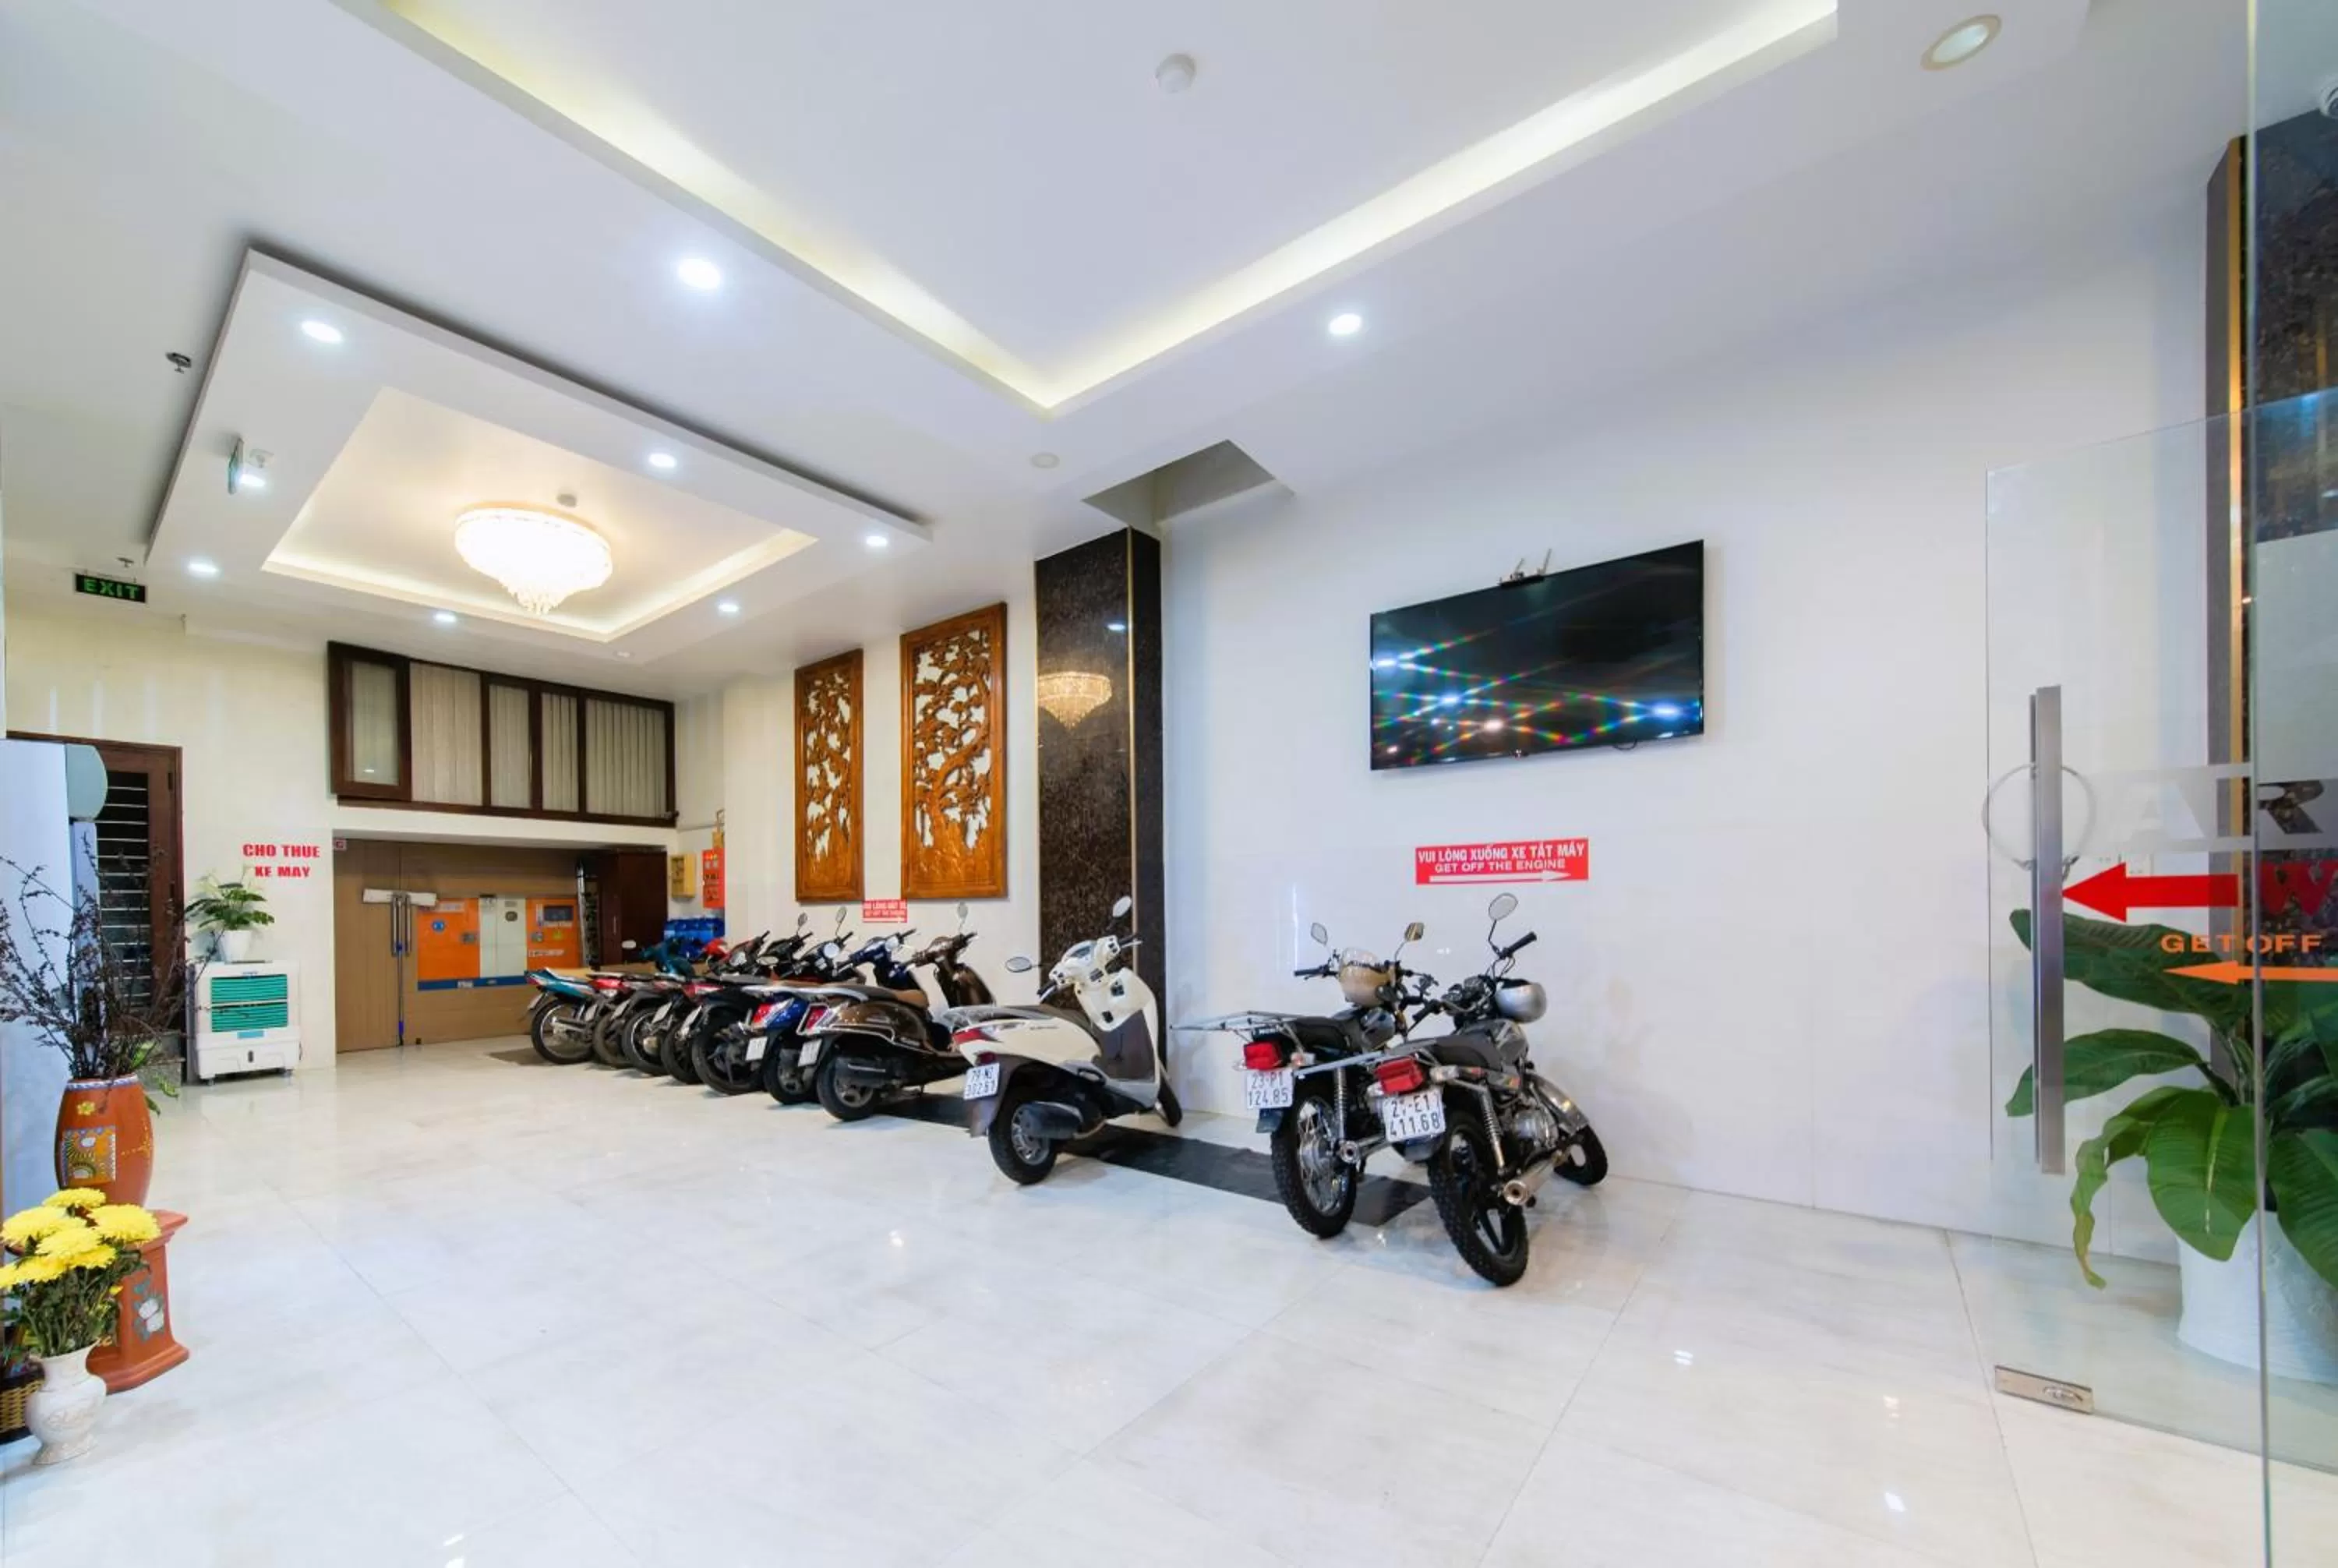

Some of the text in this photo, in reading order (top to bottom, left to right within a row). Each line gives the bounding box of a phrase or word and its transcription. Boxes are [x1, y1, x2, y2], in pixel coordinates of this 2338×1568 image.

[83, 577, 138, 599] EXIT
[242, 844, 277, 857] CHO
[1418, 850, 1436, 863] VUI
[1511, 846, 1527, 860] XE
[1435, 858, 1566, 873] GET OFF THE ENGINE
[2160, 934, 2322, 954] GET OFF
